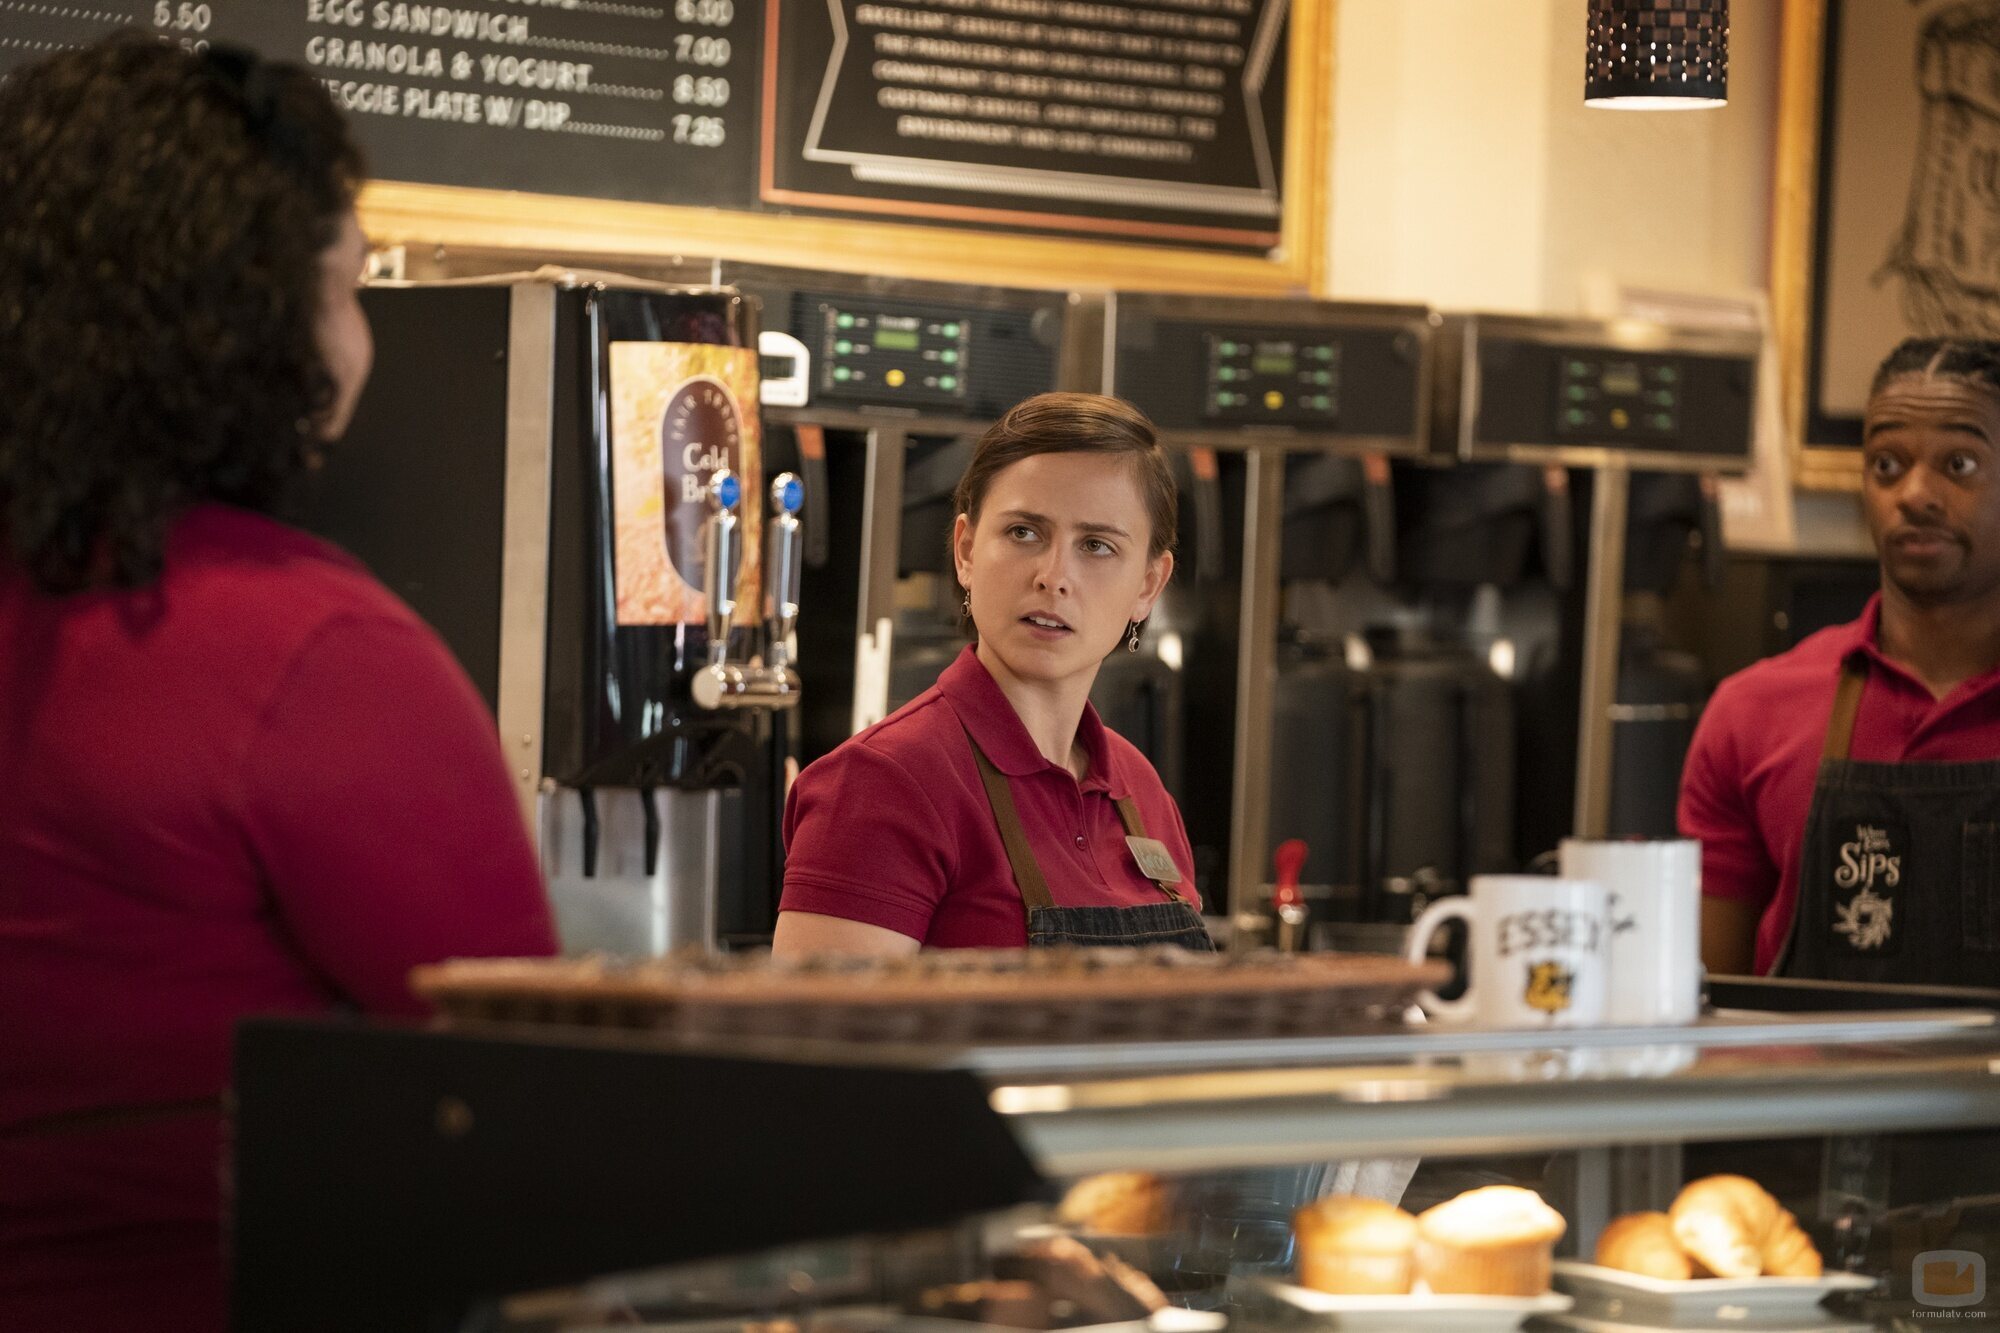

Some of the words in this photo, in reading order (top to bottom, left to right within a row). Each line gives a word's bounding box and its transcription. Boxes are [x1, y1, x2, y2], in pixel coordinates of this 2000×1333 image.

[306, 0, 365, 27] EGG
[372, 1, 529, 45] SANDWICH
[674, 34, 731, 67] 7.00
[306, 36, 444, 78] GRANOLA
[451, 51, 475, 80] &
[480, 53, 594, 93] YOGURT
[316, 77, 400, 116] EGGIE
[403, 87, 482, 124] PLATE
[524, 100, 571, 132] DIP
[683, 442, 729, 473] Cold
[682, 474, 706, 503] Br
[1834, 842, 1901, 889] Sips
